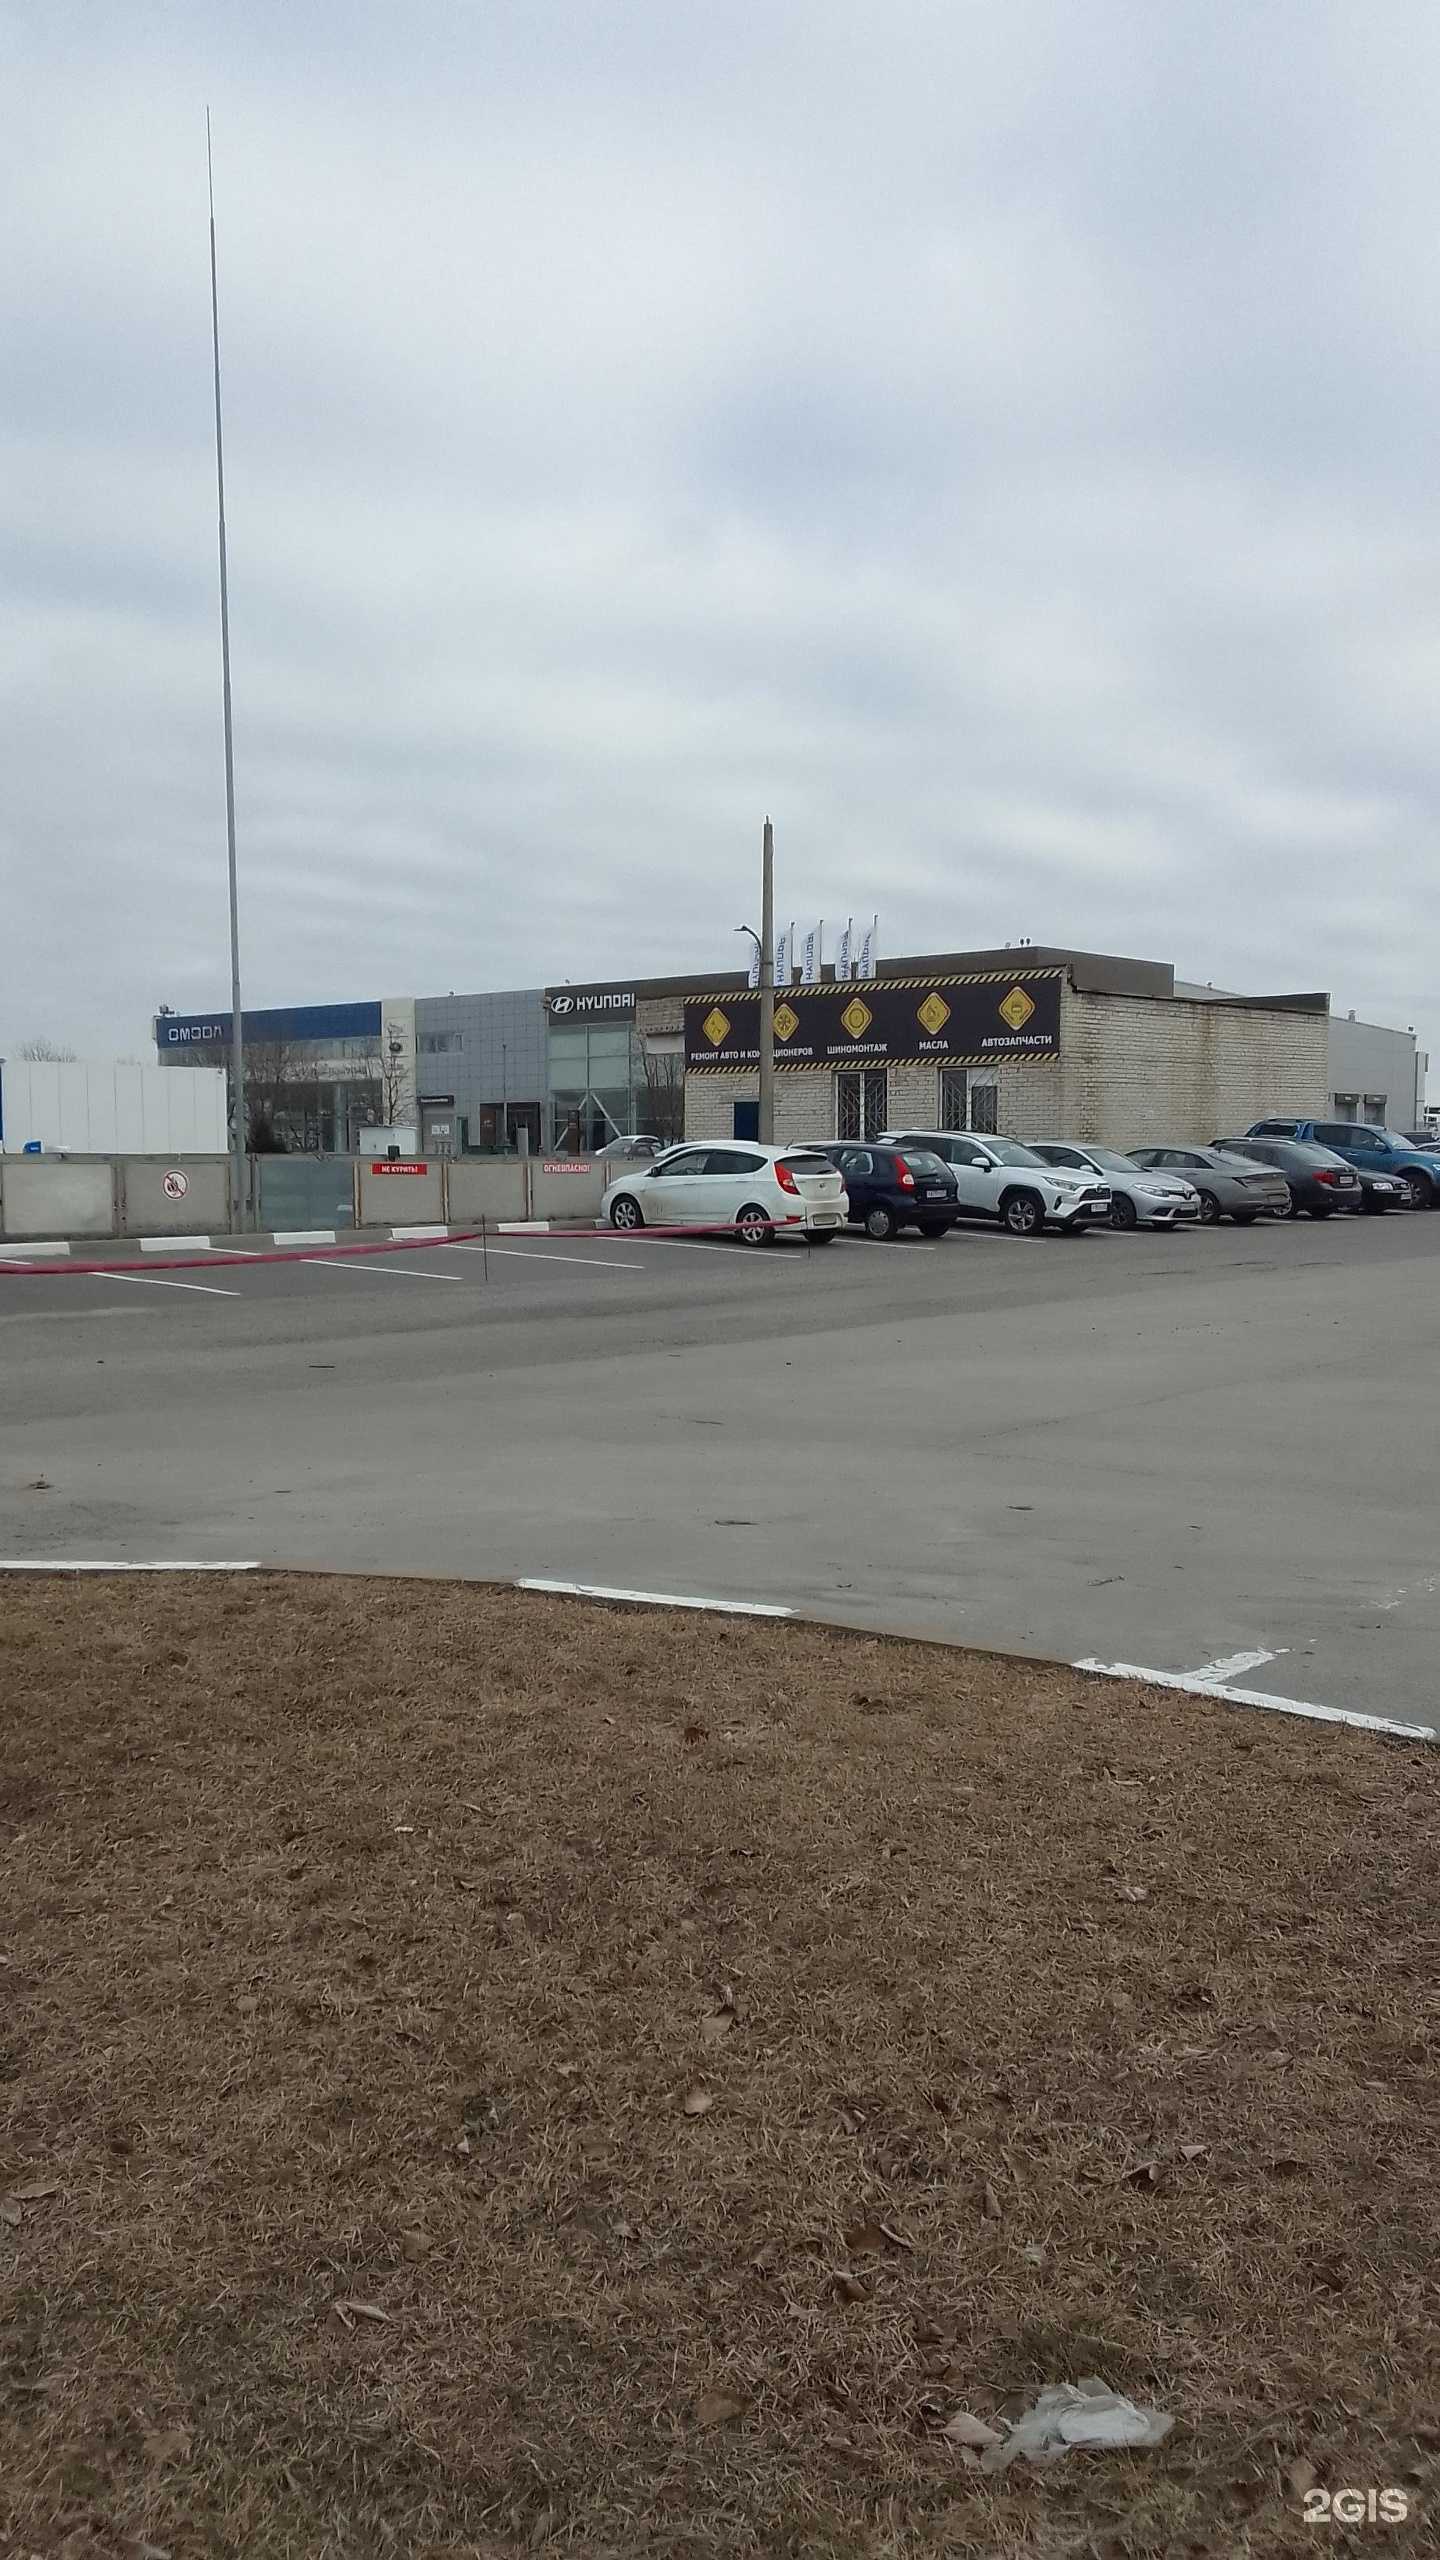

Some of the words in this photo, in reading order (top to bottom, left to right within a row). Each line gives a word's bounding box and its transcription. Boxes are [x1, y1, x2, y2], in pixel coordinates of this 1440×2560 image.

[576, 992, 635, 1011] HYUNDAI
[919, 1040, 949, 1050] МАСЛА
[981, 1035, 1052, 1047] АВТОЗАПЧАСТИ
[826, 1043, 888, 1055] ШИНОМОНТАЖ
[690, 1052, 719, 1061] РЕМОНТ
[720, 1051, 739, 1060] АВТО
[740, 1050, 746, 1058] И
